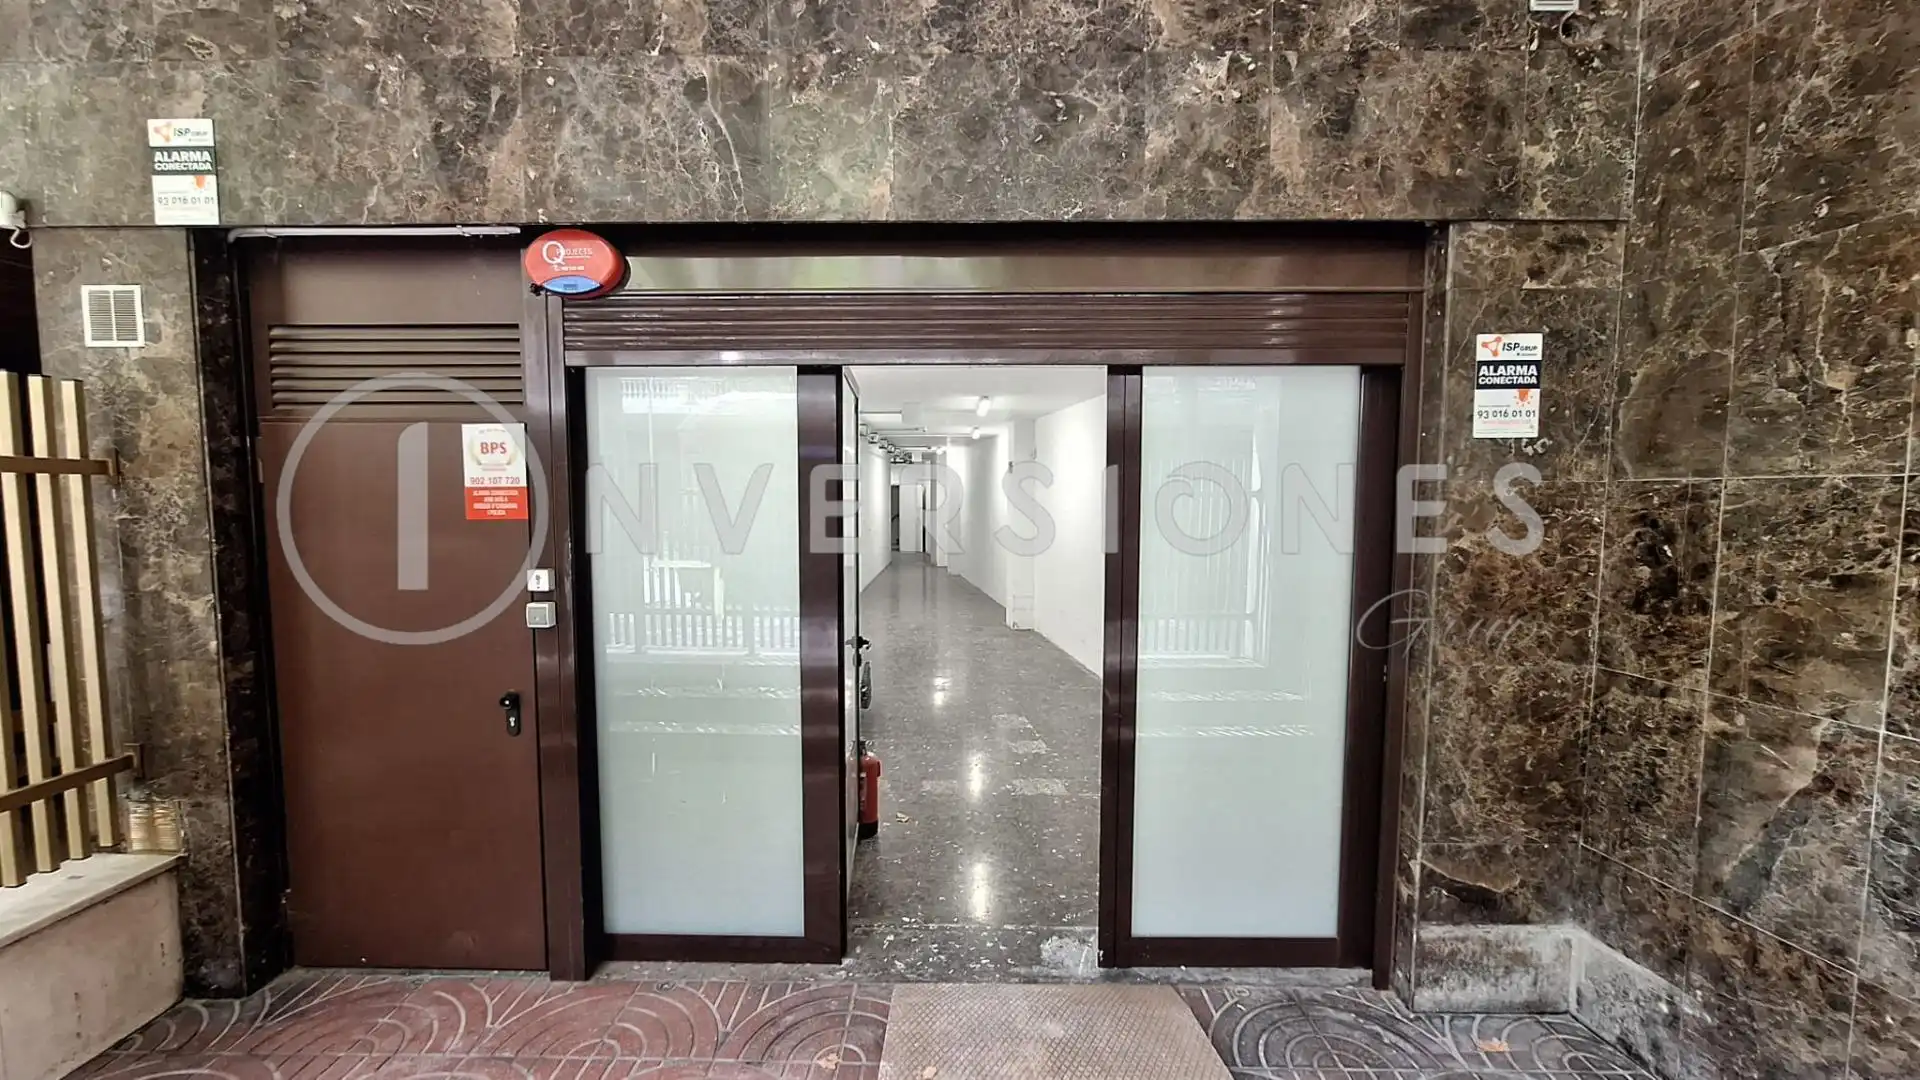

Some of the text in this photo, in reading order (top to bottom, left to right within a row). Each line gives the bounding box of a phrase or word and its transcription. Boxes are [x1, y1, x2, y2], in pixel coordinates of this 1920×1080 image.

[173, 127, 191, 137] ISP
[154, 150, 212, 162] ALARMA
[154, 162, 213, 171] CONECTADA
[172, 196, 188, 204] 016
[191, 196, 202, 204] 01
[204, 196, 215, 204] 01
[542, 241, 565, 265] Q
[1502, 342, 1520, 351] ISP
[1479, 365, 1538, 376] ALARMA
[1478, 376, 1537, 384] CONECTADA
[1477, 408, 1536, 419] 93 016 01 01
[480, 442, 507, 454] BPS
